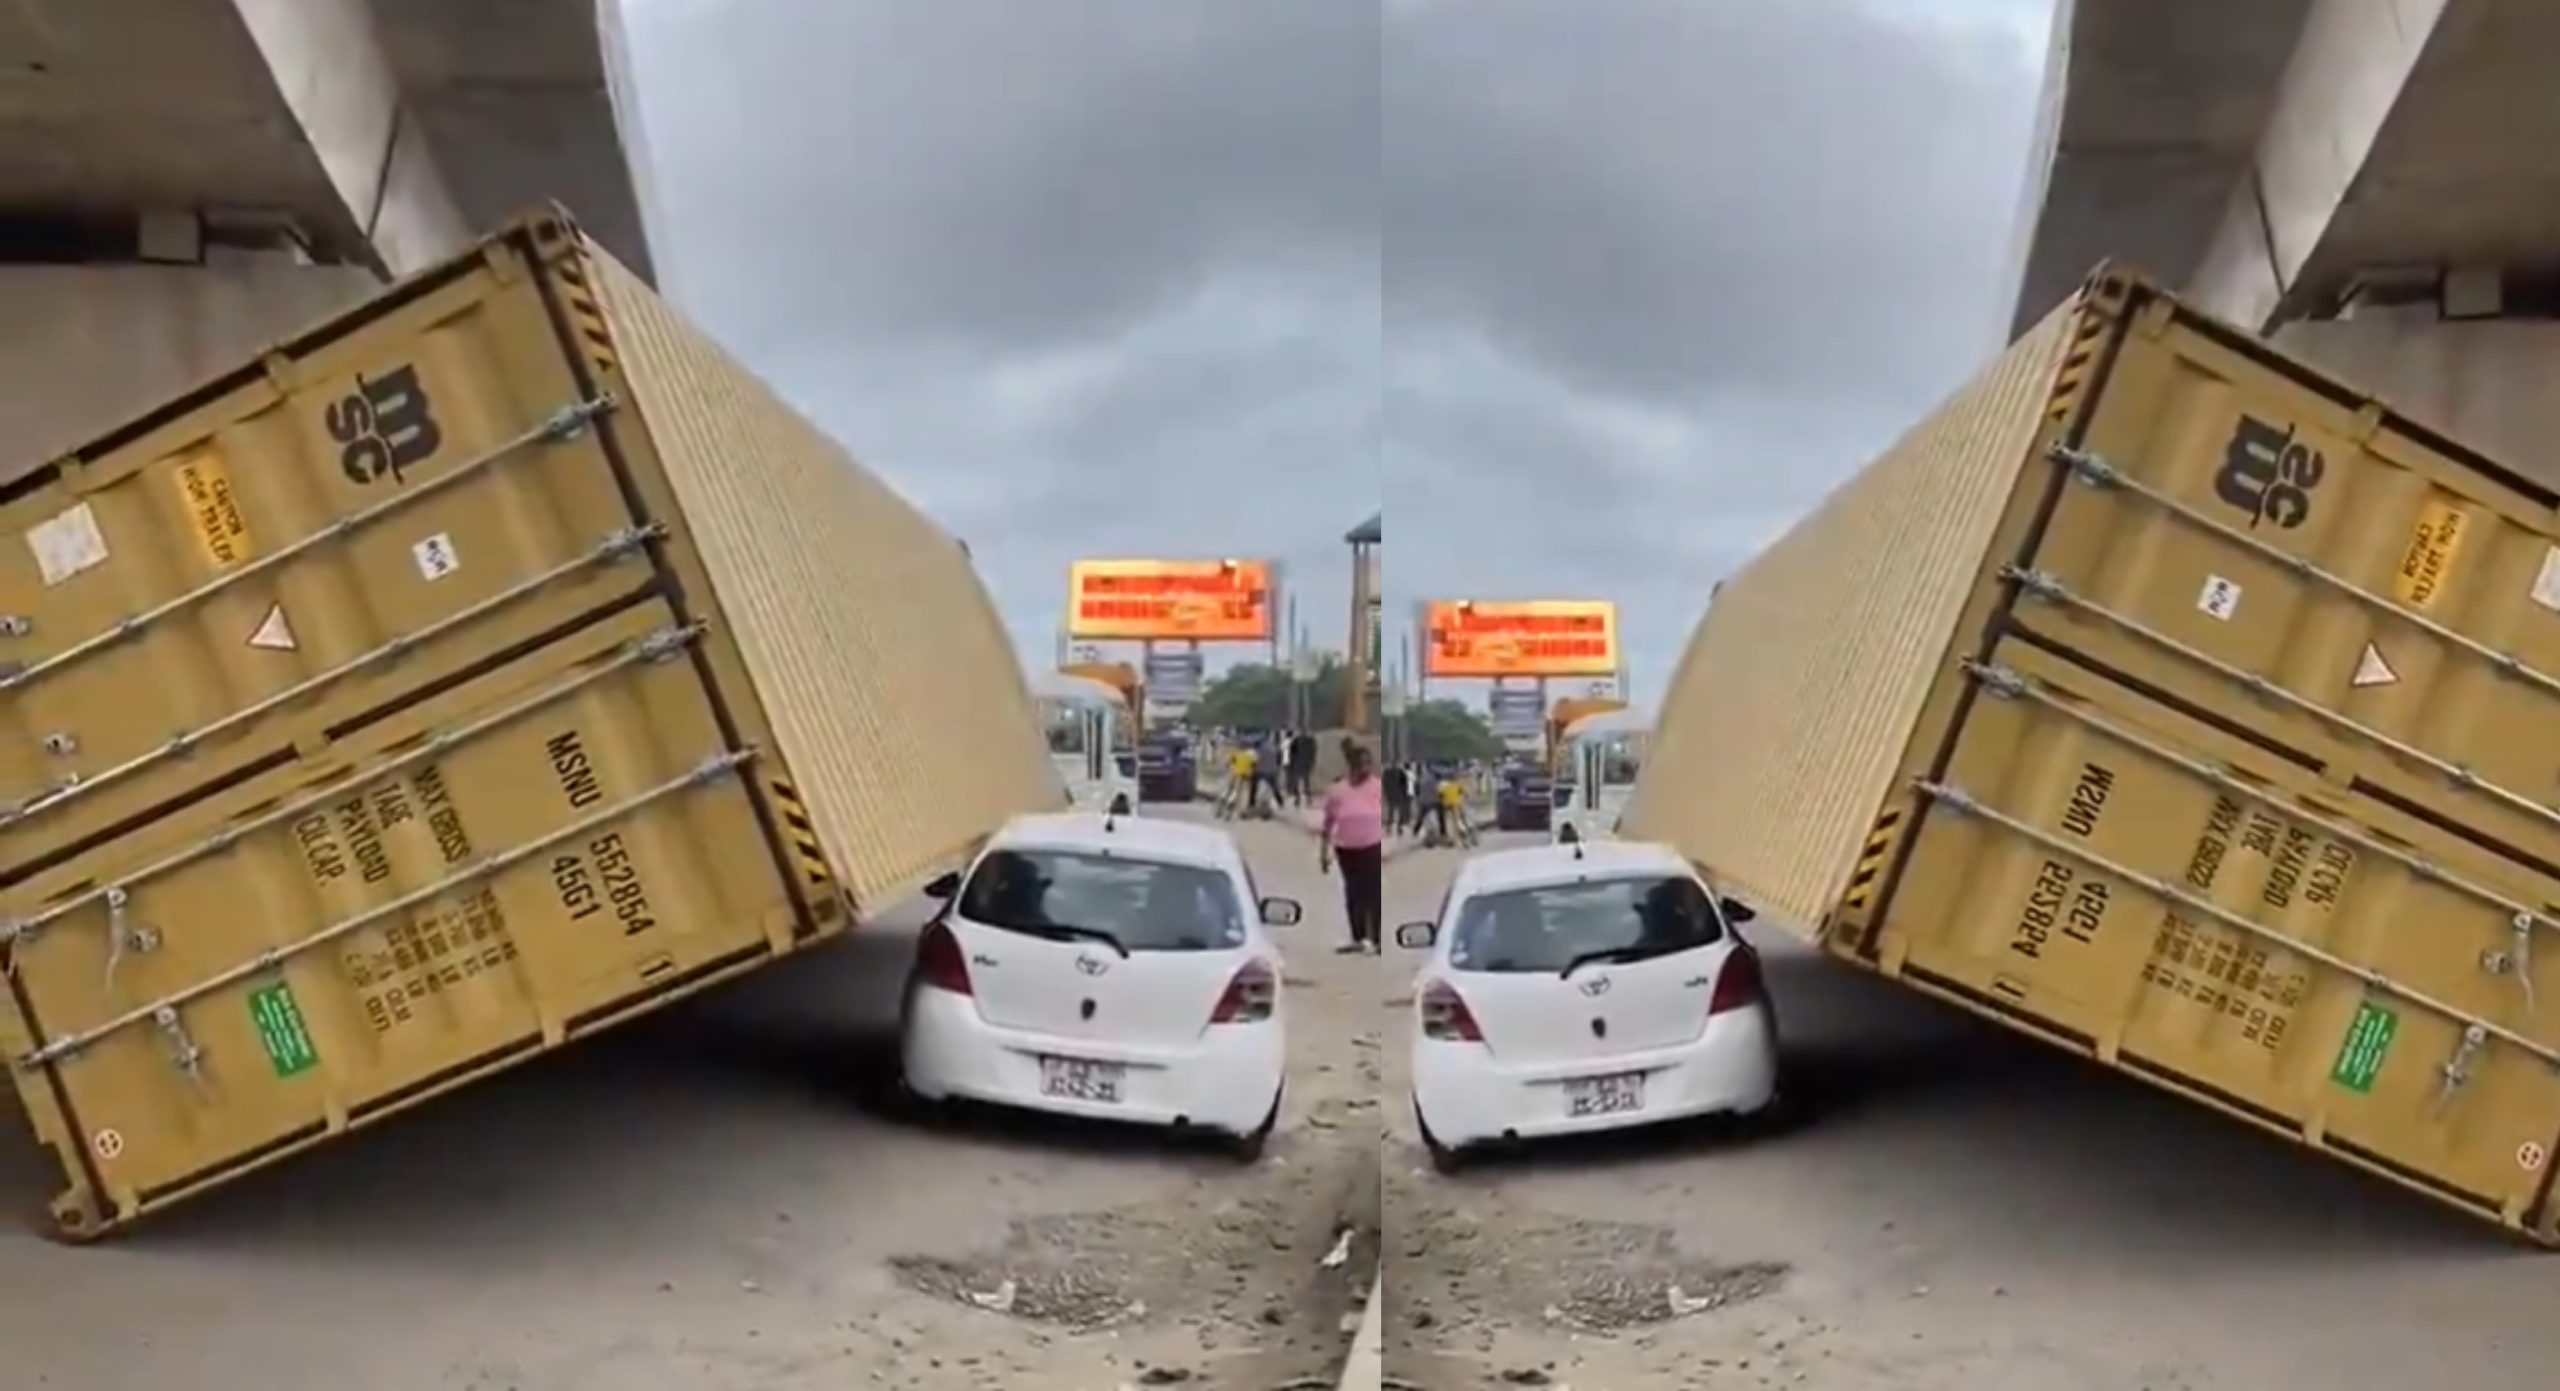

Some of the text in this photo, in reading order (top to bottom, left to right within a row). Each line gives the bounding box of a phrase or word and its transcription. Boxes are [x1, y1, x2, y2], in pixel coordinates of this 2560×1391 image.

[370, 782, 412, 830] TARE
[410, 764, 449, 809] MAX
[333, 797, 390, 884] PAYLOAD
[427, 807, 471, 864] GROSS
[544, 730, 672, 978] MSNU 552854 1
[550, 853, 602, 920] 45G1
